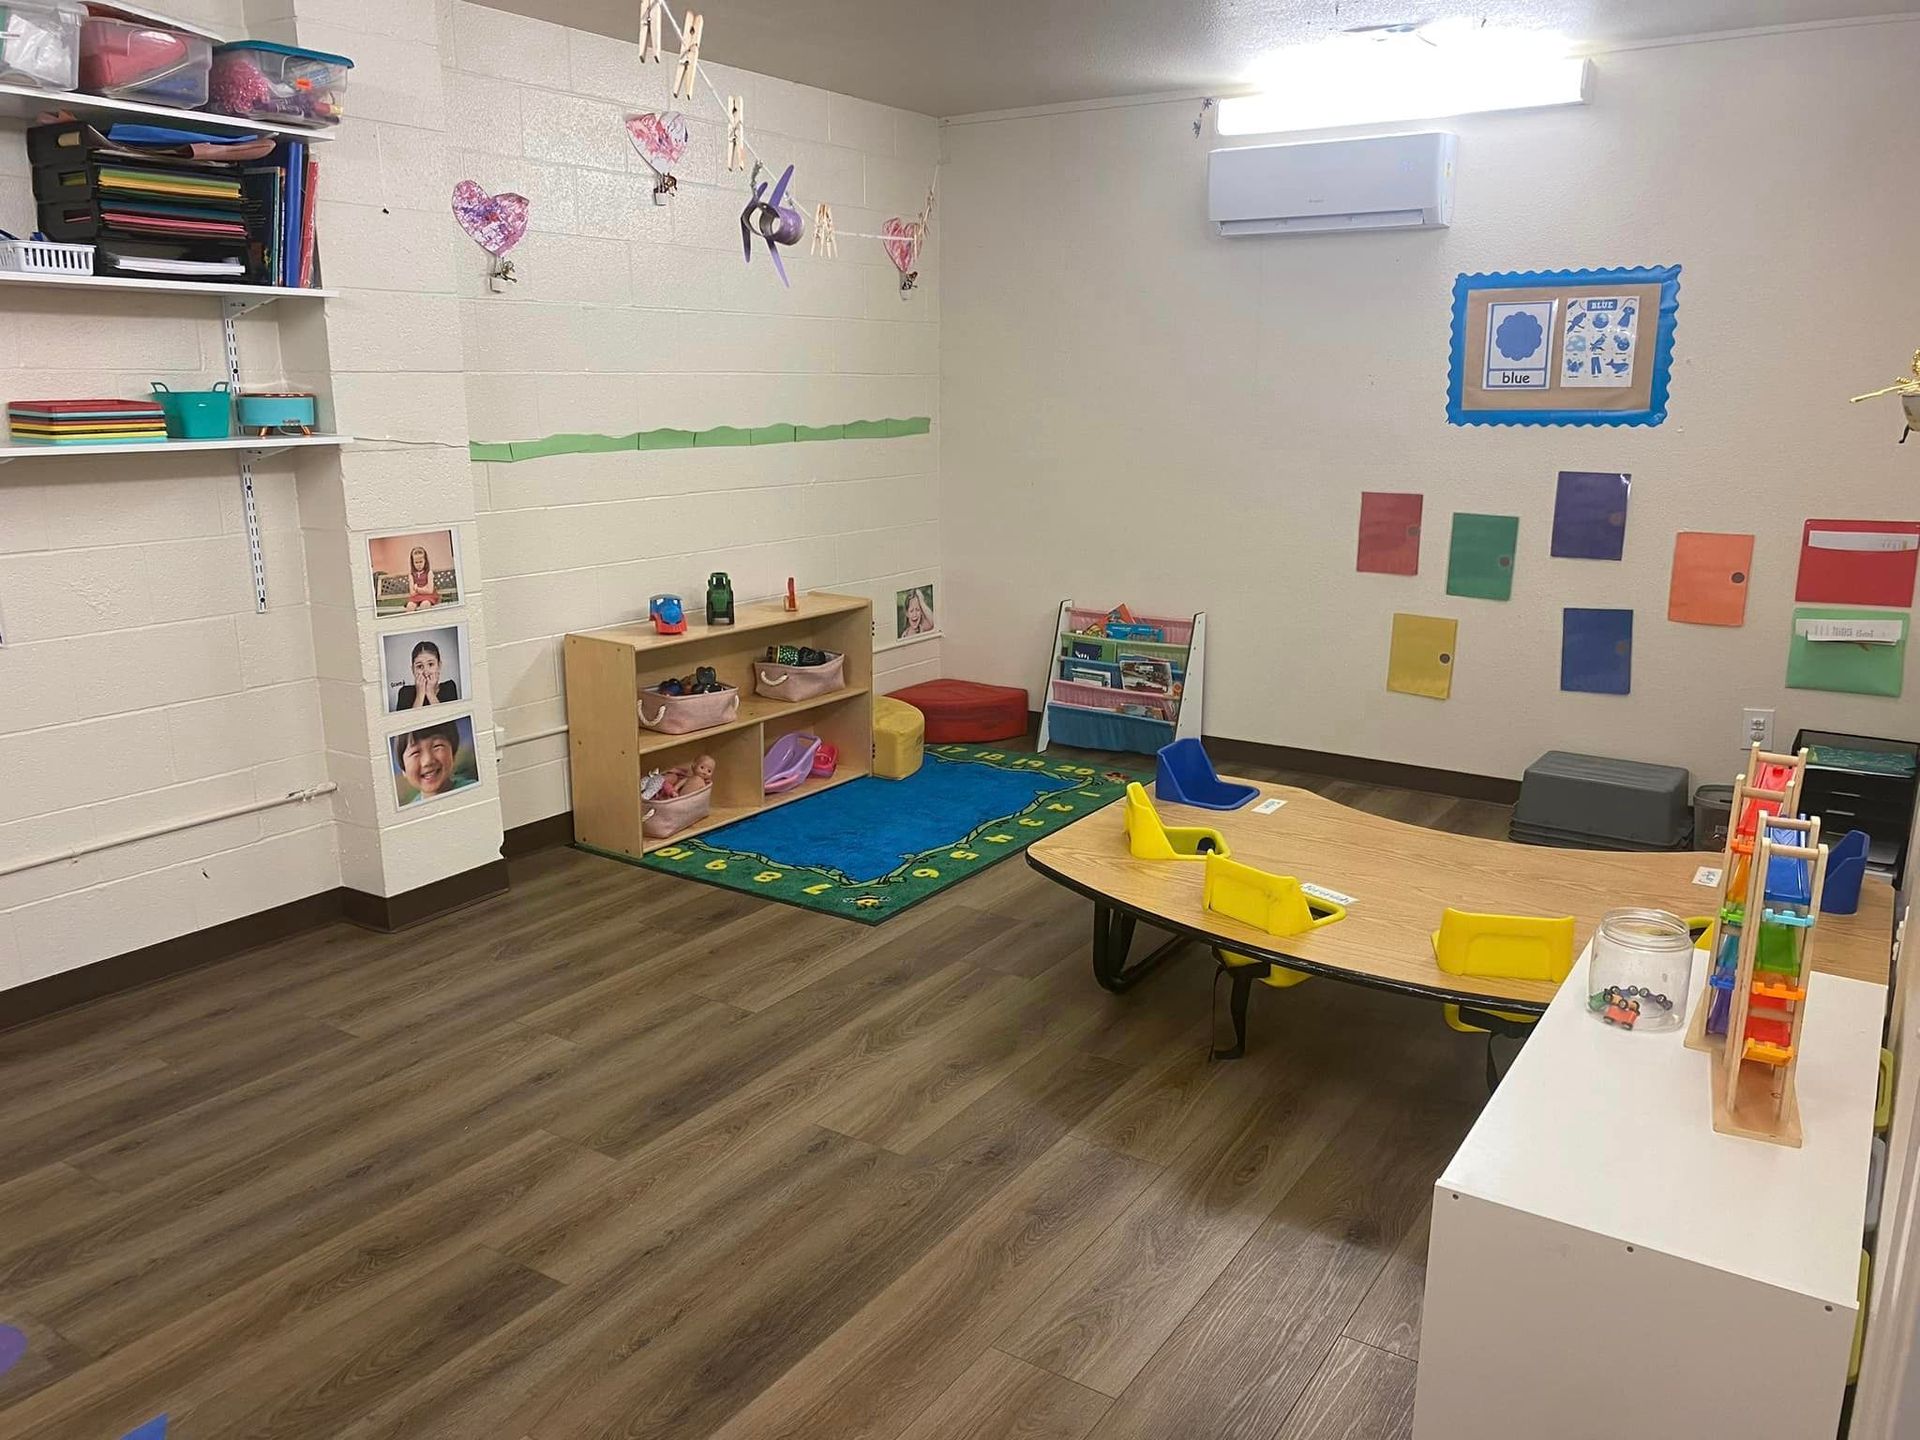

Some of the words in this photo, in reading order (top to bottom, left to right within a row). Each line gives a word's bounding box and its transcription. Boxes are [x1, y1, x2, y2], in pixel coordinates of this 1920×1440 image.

[1591, 301, 1614, 309] BLUE
[1502, 371, 1530, 384] blue
[937, 745, 968, 753] 17
[974, 751, 1005, 761] 18
[1012, 758, 1045, 768] 19
[1054, 765, 1095, 775] 20
[1047, 803, 1074, 812] 2
[1018, 818, 1045, 827] 3
[983, 834, 1014, 843] 4
[950, 850, 980, 860] 5
[654, 847, 694, 860] 10
[705, 859, 728, 870] 9
[753, 871, 783, 883] 8
[802, 883, 833, 895] 7
[912, 868, 940, 879] 6
